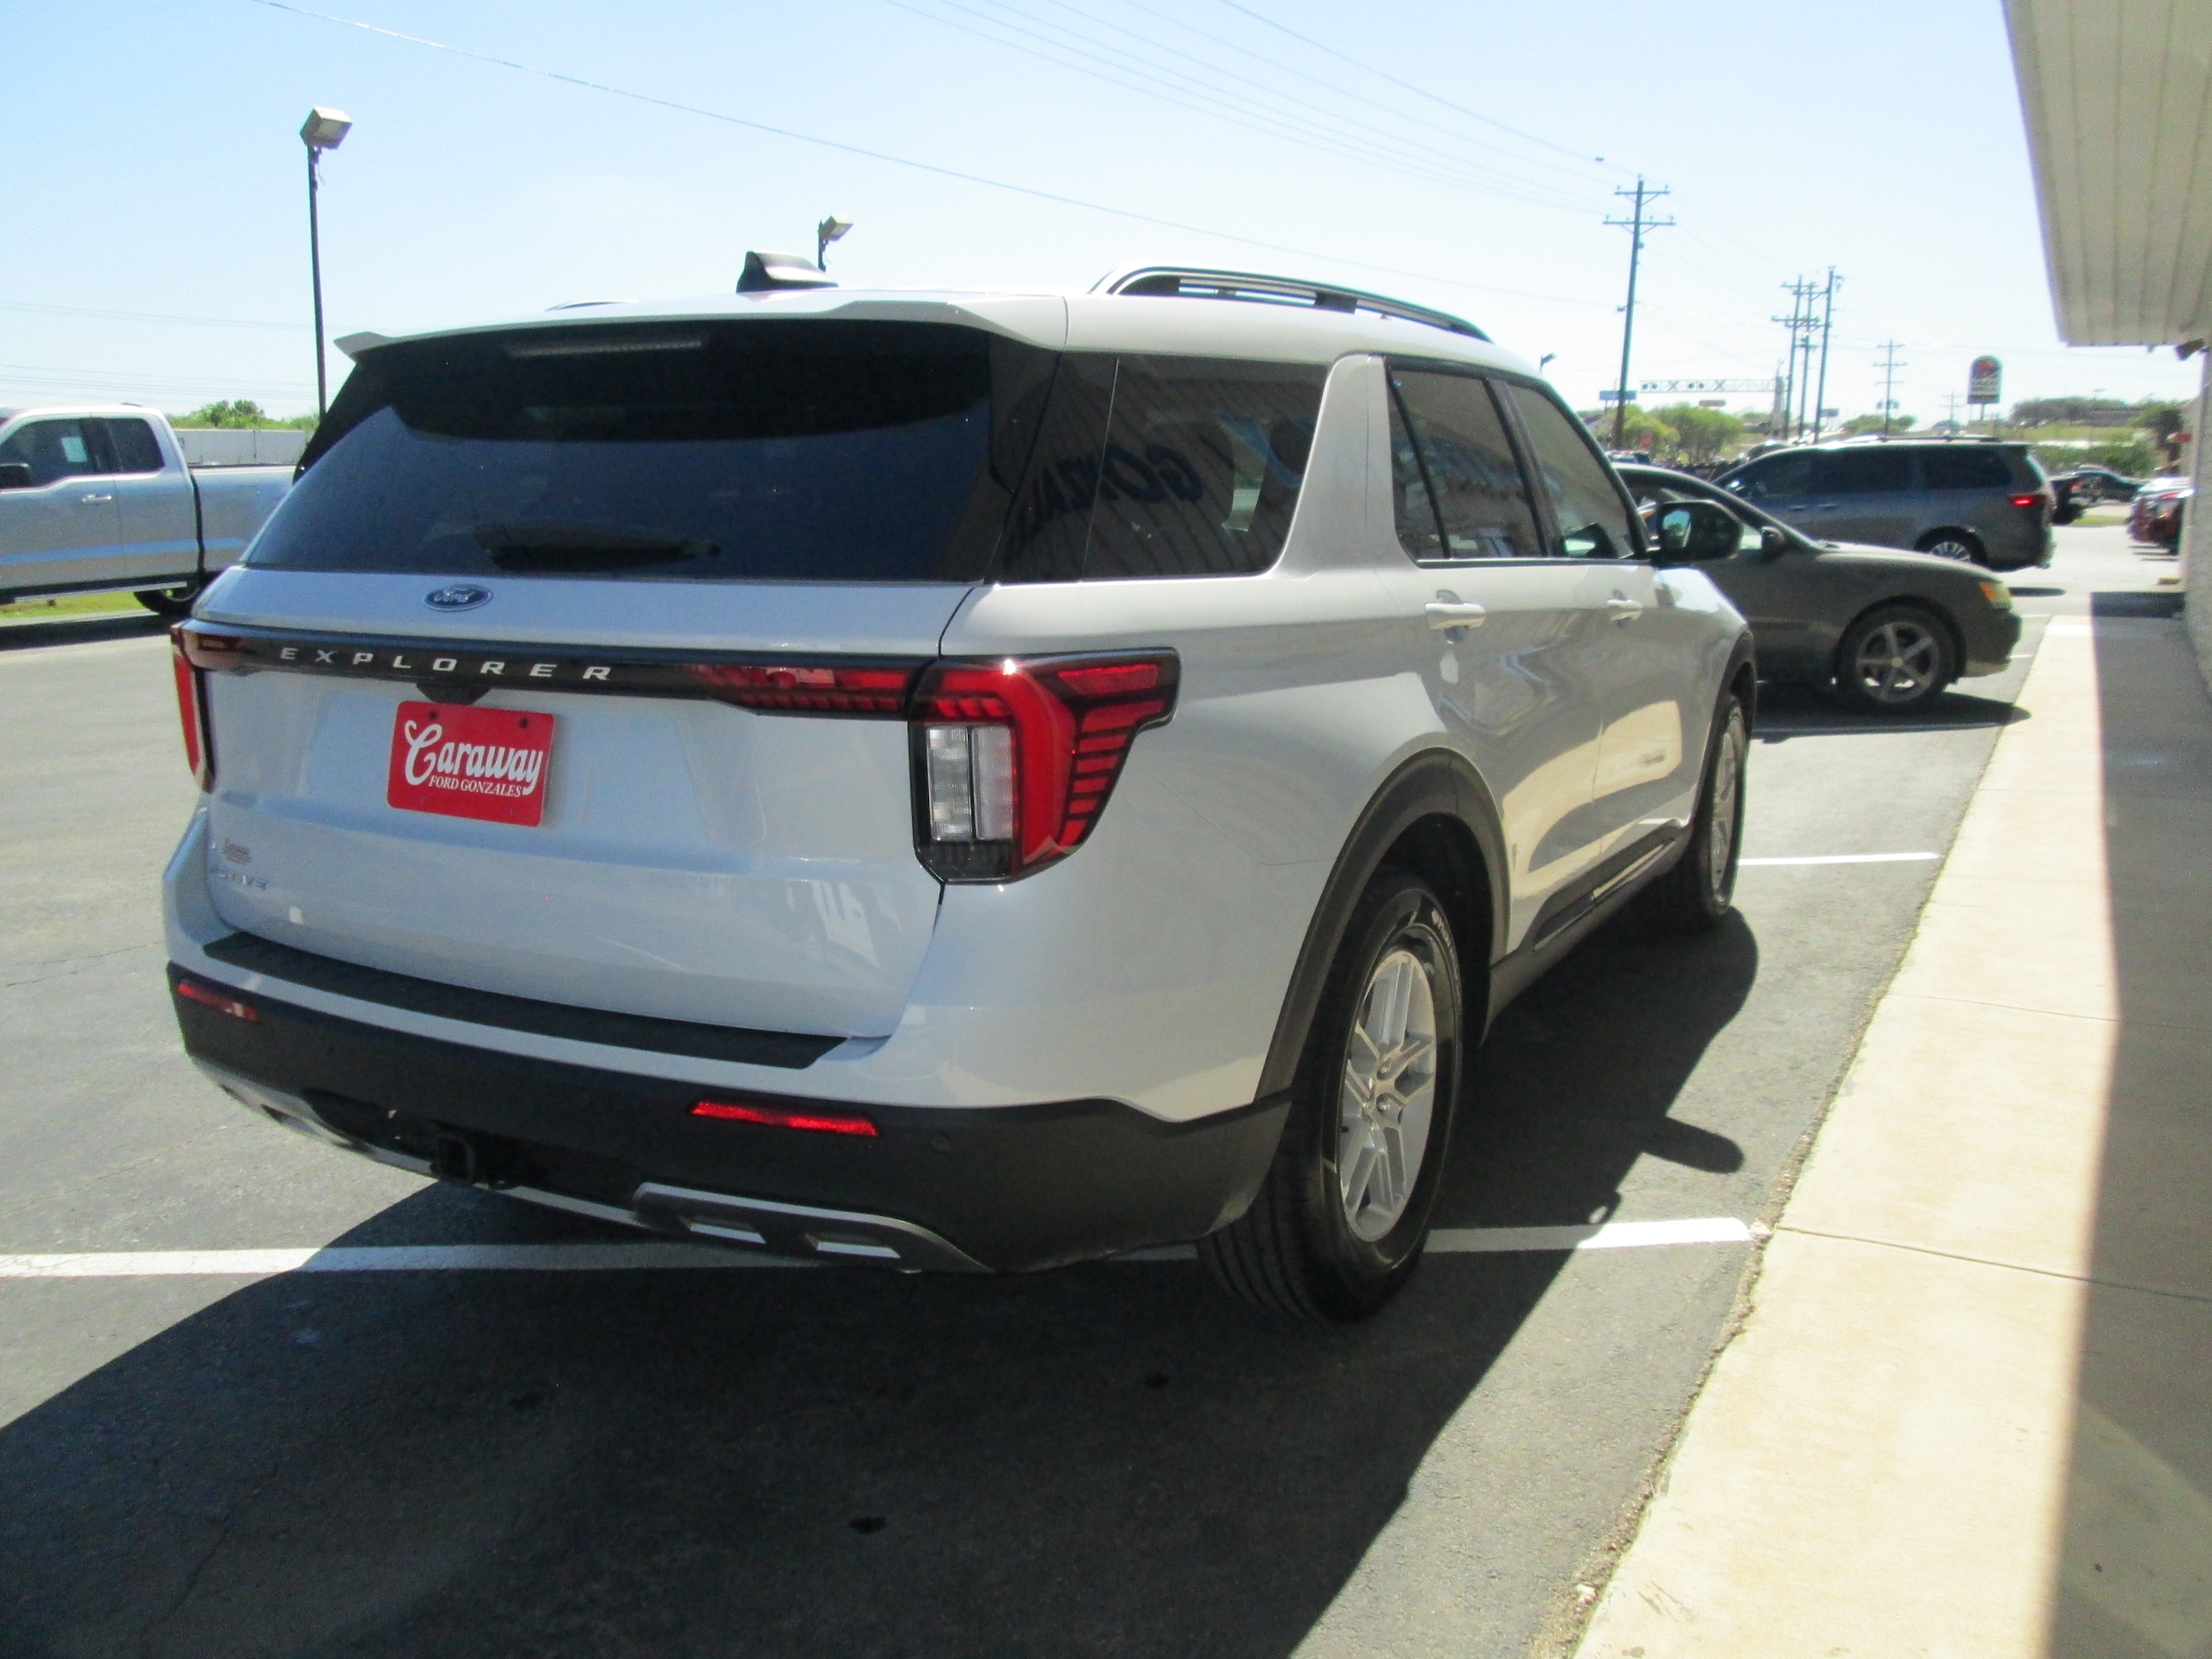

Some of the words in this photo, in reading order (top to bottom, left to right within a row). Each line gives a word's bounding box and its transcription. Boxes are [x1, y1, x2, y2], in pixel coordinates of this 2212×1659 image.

[433, 587, 475, 604] Ford
[280, 647, 611, 681] EXPLORER
[403, 719, 543, 795] Caraway
[428, 775, 459, 790] FORD
[460, 779, 522, 797] GONZALES
